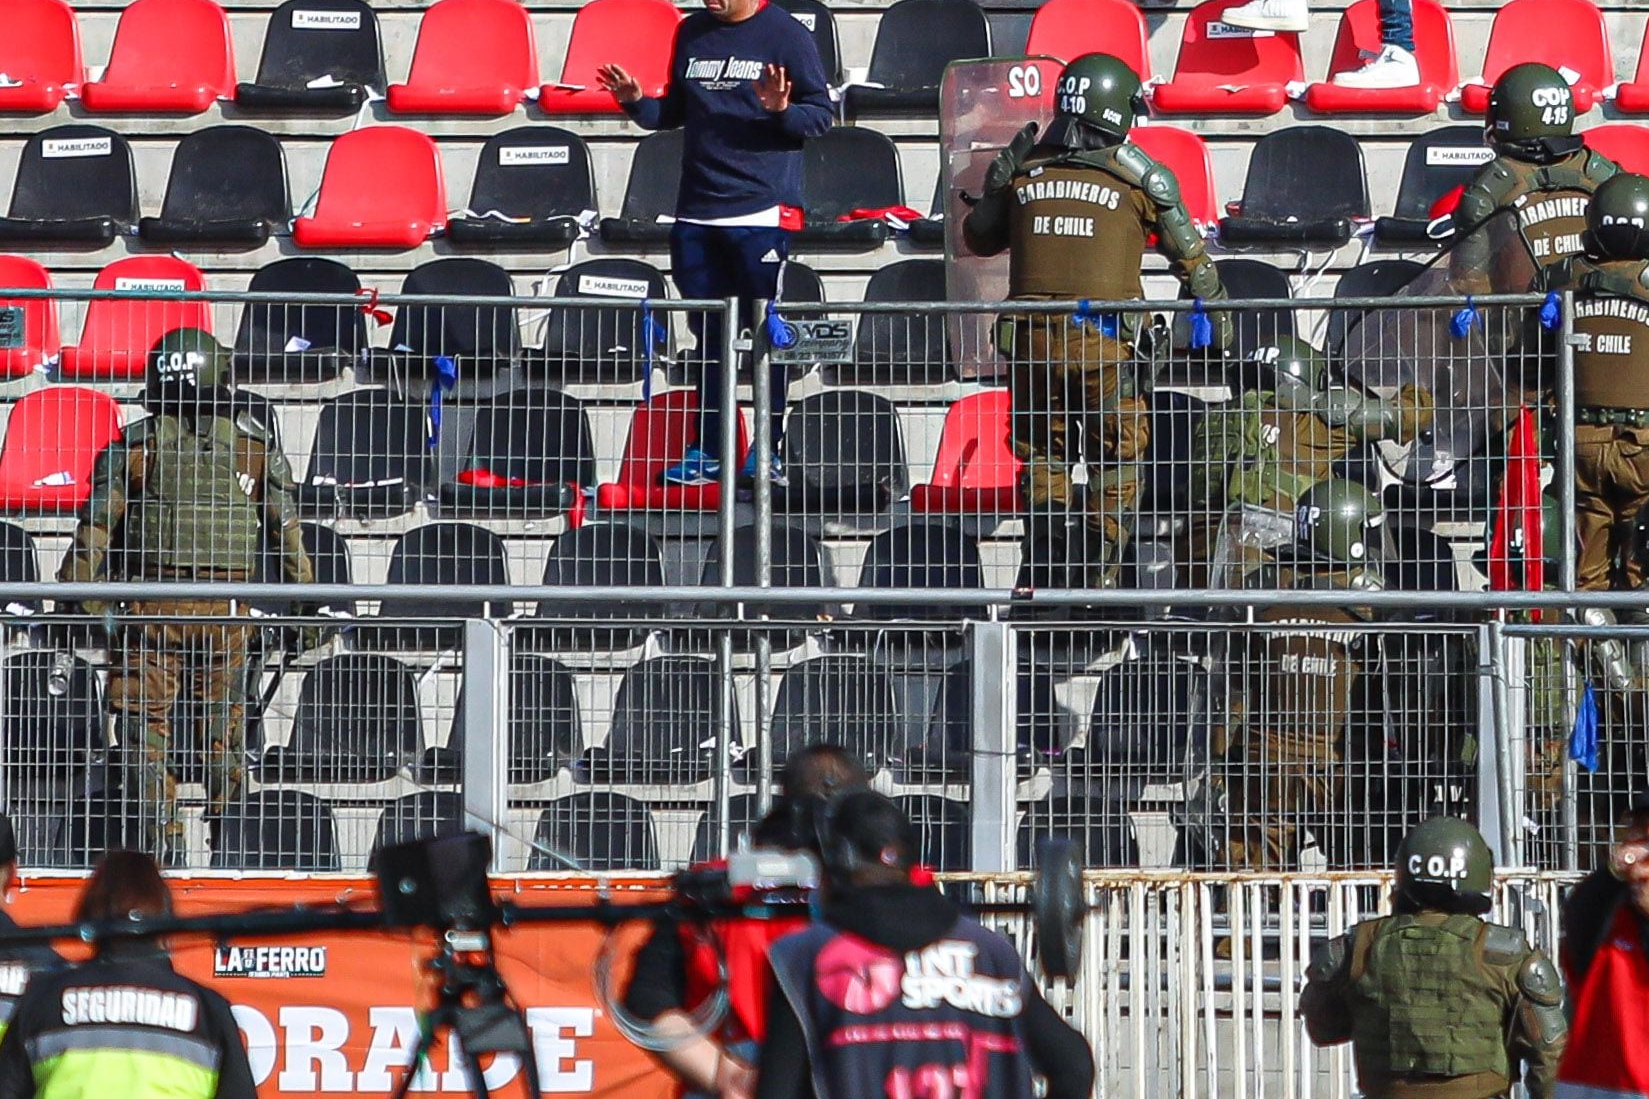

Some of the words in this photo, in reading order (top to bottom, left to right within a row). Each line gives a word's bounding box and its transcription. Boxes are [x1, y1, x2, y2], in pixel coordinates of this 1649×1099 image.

[307, 15, 358, 25] HABILITADO
[685, 59, 724, 82] Tommy
[724, 56, 764, 81] Jeans
[58, 141, 109, 153] HABILITADO
[514, 149, 567, 161] HABILITADO
[1442, 151, 1494, 162] HABILITADO
[1017, 179, 1122, 212] CARABINEROS
[1033, 216, 1053, 237] DE
[1054, 216, 1096, 238] CHILE
[1533, 233, 1551, 258] DE
[1554, 231, 1587, 255] CHIL
[594, 280, 647, 294] HABILITADO
[1596, 334, 1632, 355] CHILE
[214, 947, 247, 973] LA
[256, 948, 326, 973] FERRO
[61, 987, 200, 1034] SEGURIDAD
